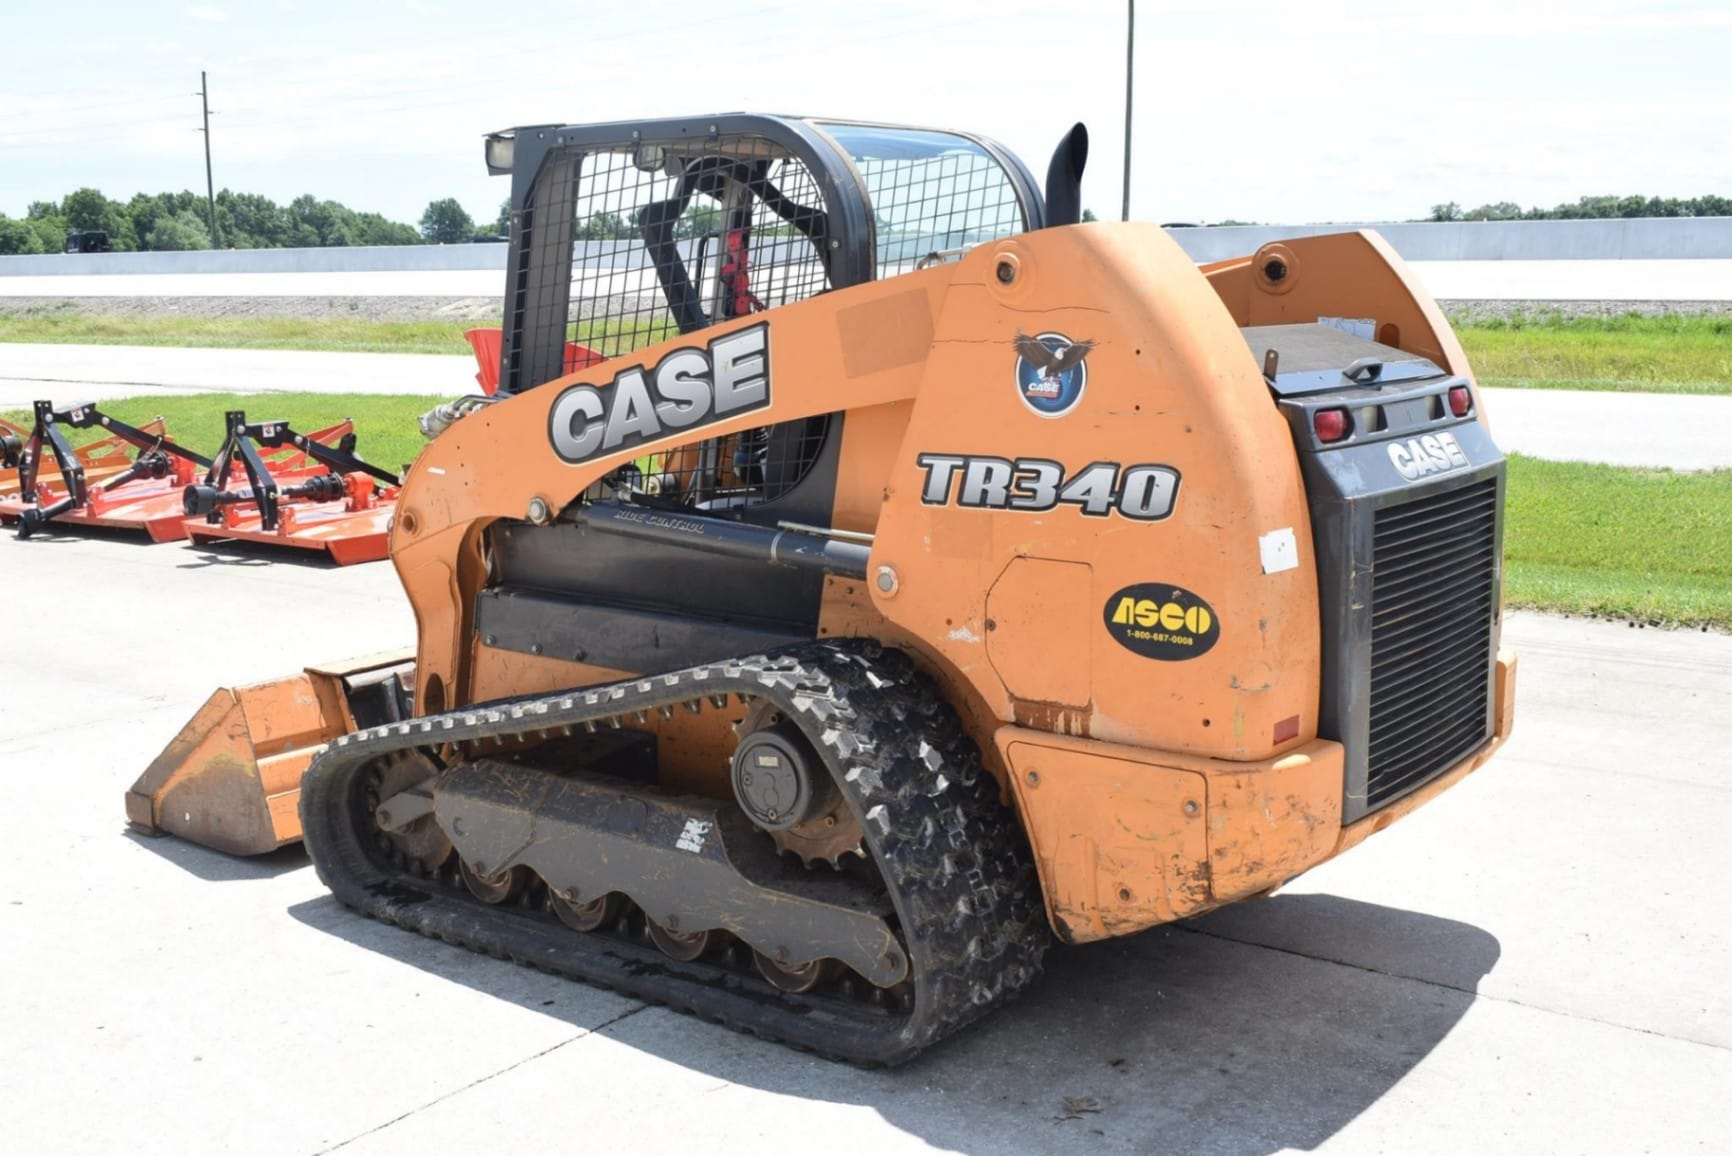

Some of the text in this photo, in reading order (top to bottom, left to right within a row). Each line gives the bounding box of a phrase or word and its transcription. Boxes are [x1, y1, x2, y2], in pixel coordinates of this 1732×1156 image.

[549, 321, 769, 462] CASE
[1028, 381, 1060, 393] CASE
[1387, 431, 1468, 480] CASE
[918, 453, 1181, 520] TR340
[1112, 597, 1211, 634] ASCO
